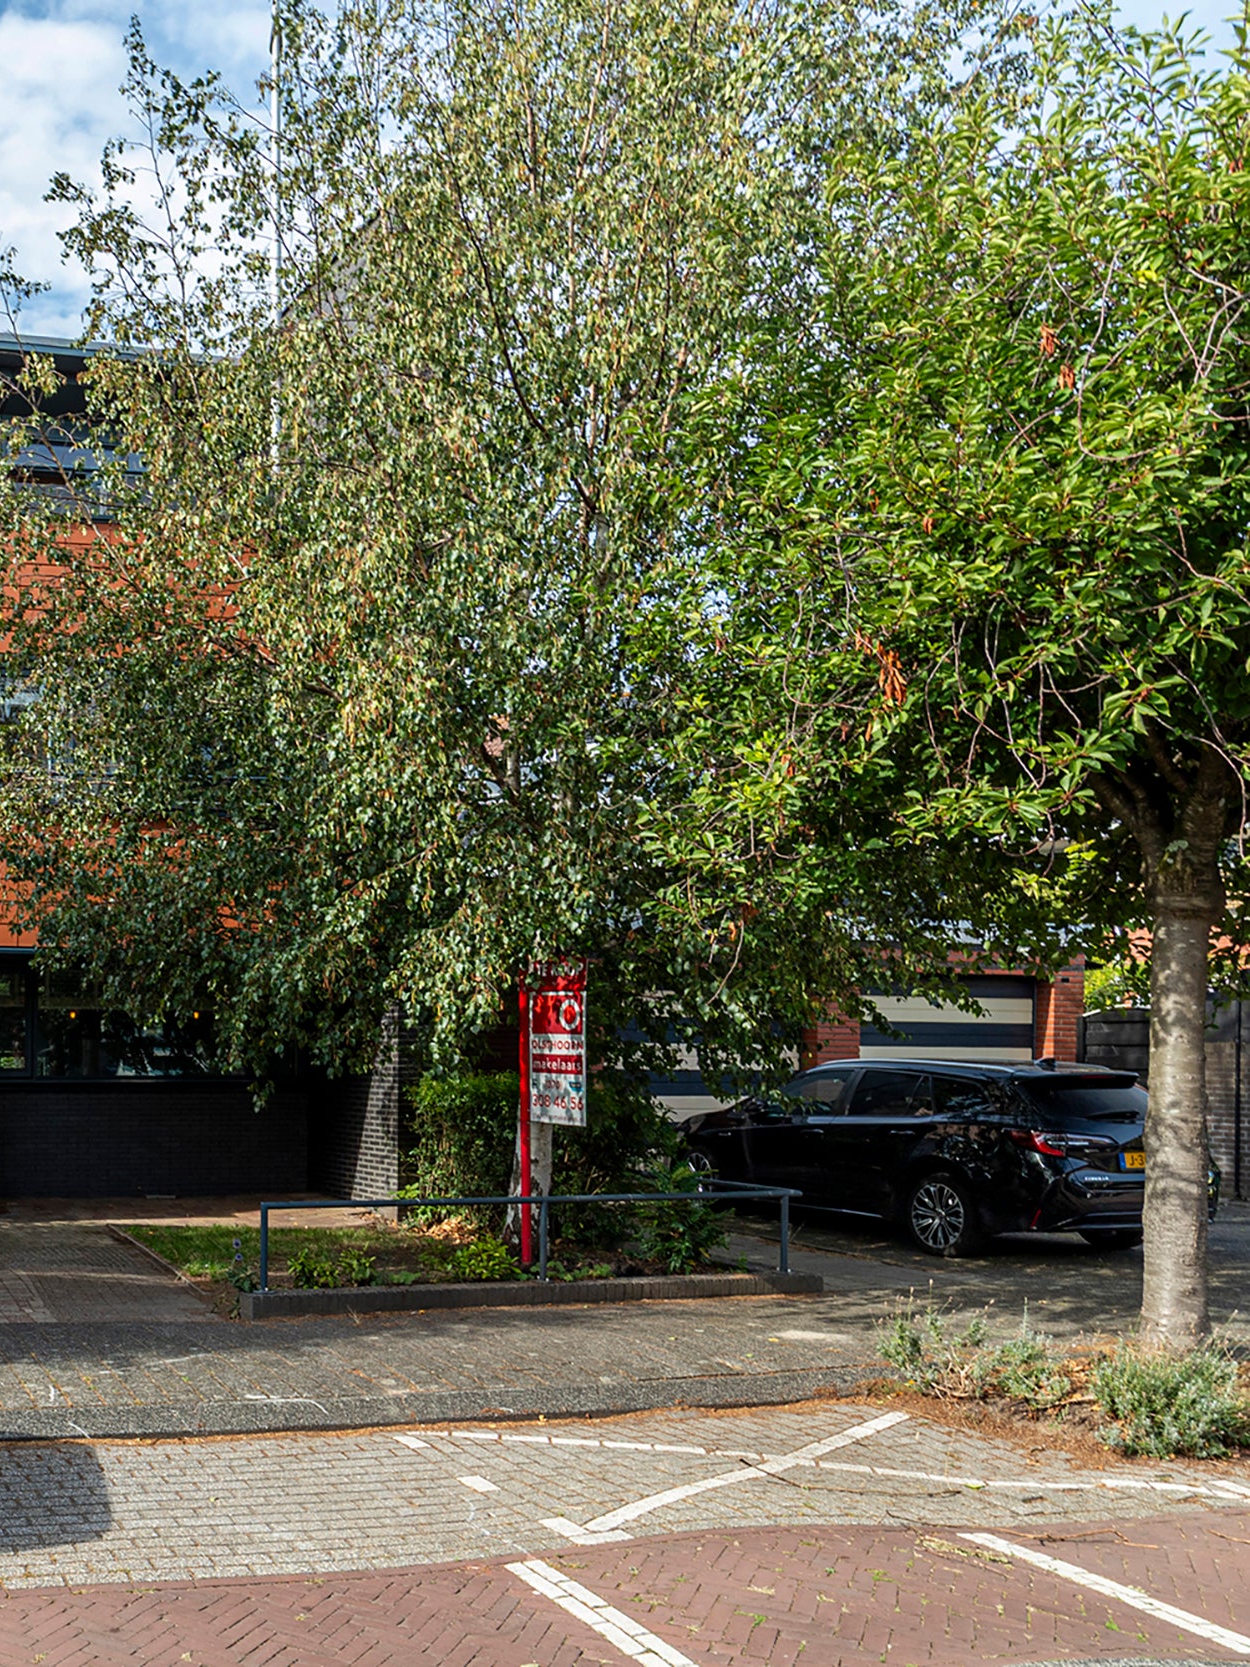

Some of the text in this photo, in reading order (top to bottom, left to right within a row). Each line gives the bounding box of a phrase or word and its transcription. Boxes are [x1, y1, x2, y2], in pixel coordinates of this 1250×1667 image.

[533, 1057, 582, 1072] makelaars
[533, 1093, 584, 1111] 308 46 56
